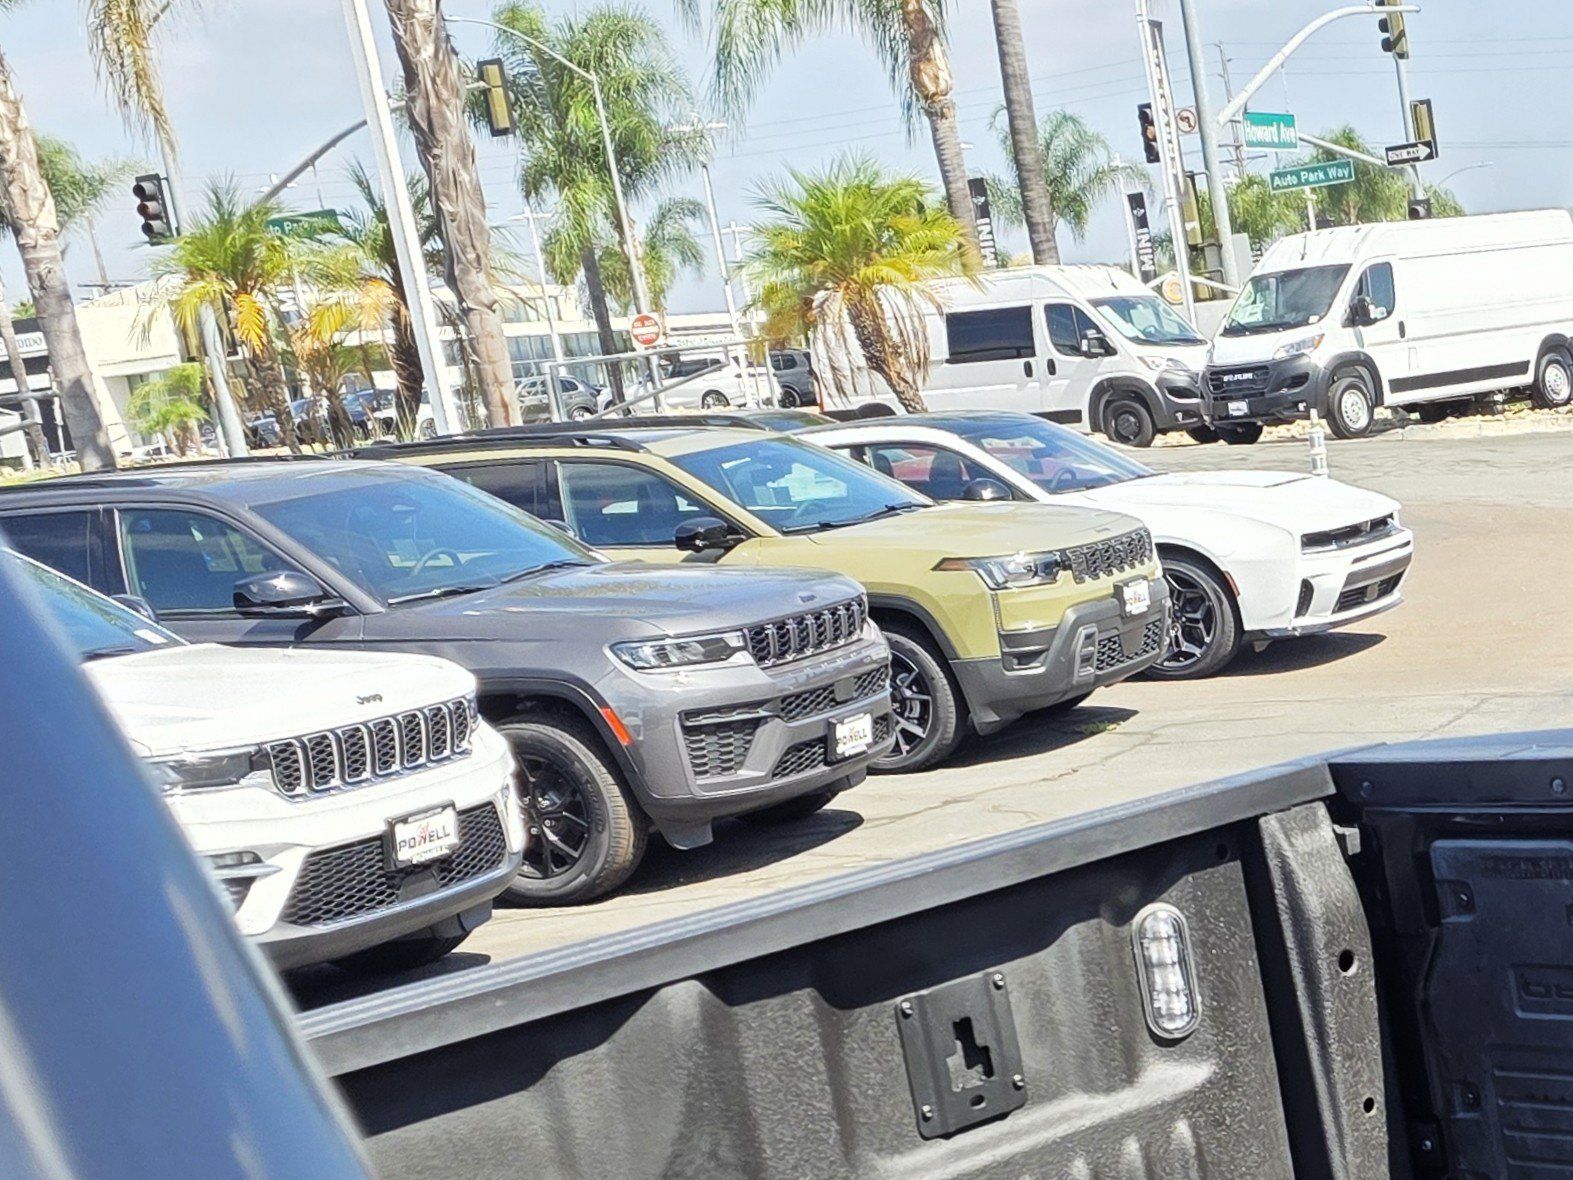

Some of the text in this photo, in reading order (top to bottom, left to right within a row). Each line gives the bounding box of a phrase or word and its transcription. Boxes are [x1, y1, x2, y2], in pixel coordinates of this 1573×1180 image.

[1245, 121, 1297, 144] Howard Ave
[1390, 149, 1420, 160] ONE WAY
[1273, 164, 1350, 188] Auto Park Way
[977, 218, 998, 268] MINI
[1137, 228, 1156, 271] MINI
[398, 825, 451, 852] POWELL
